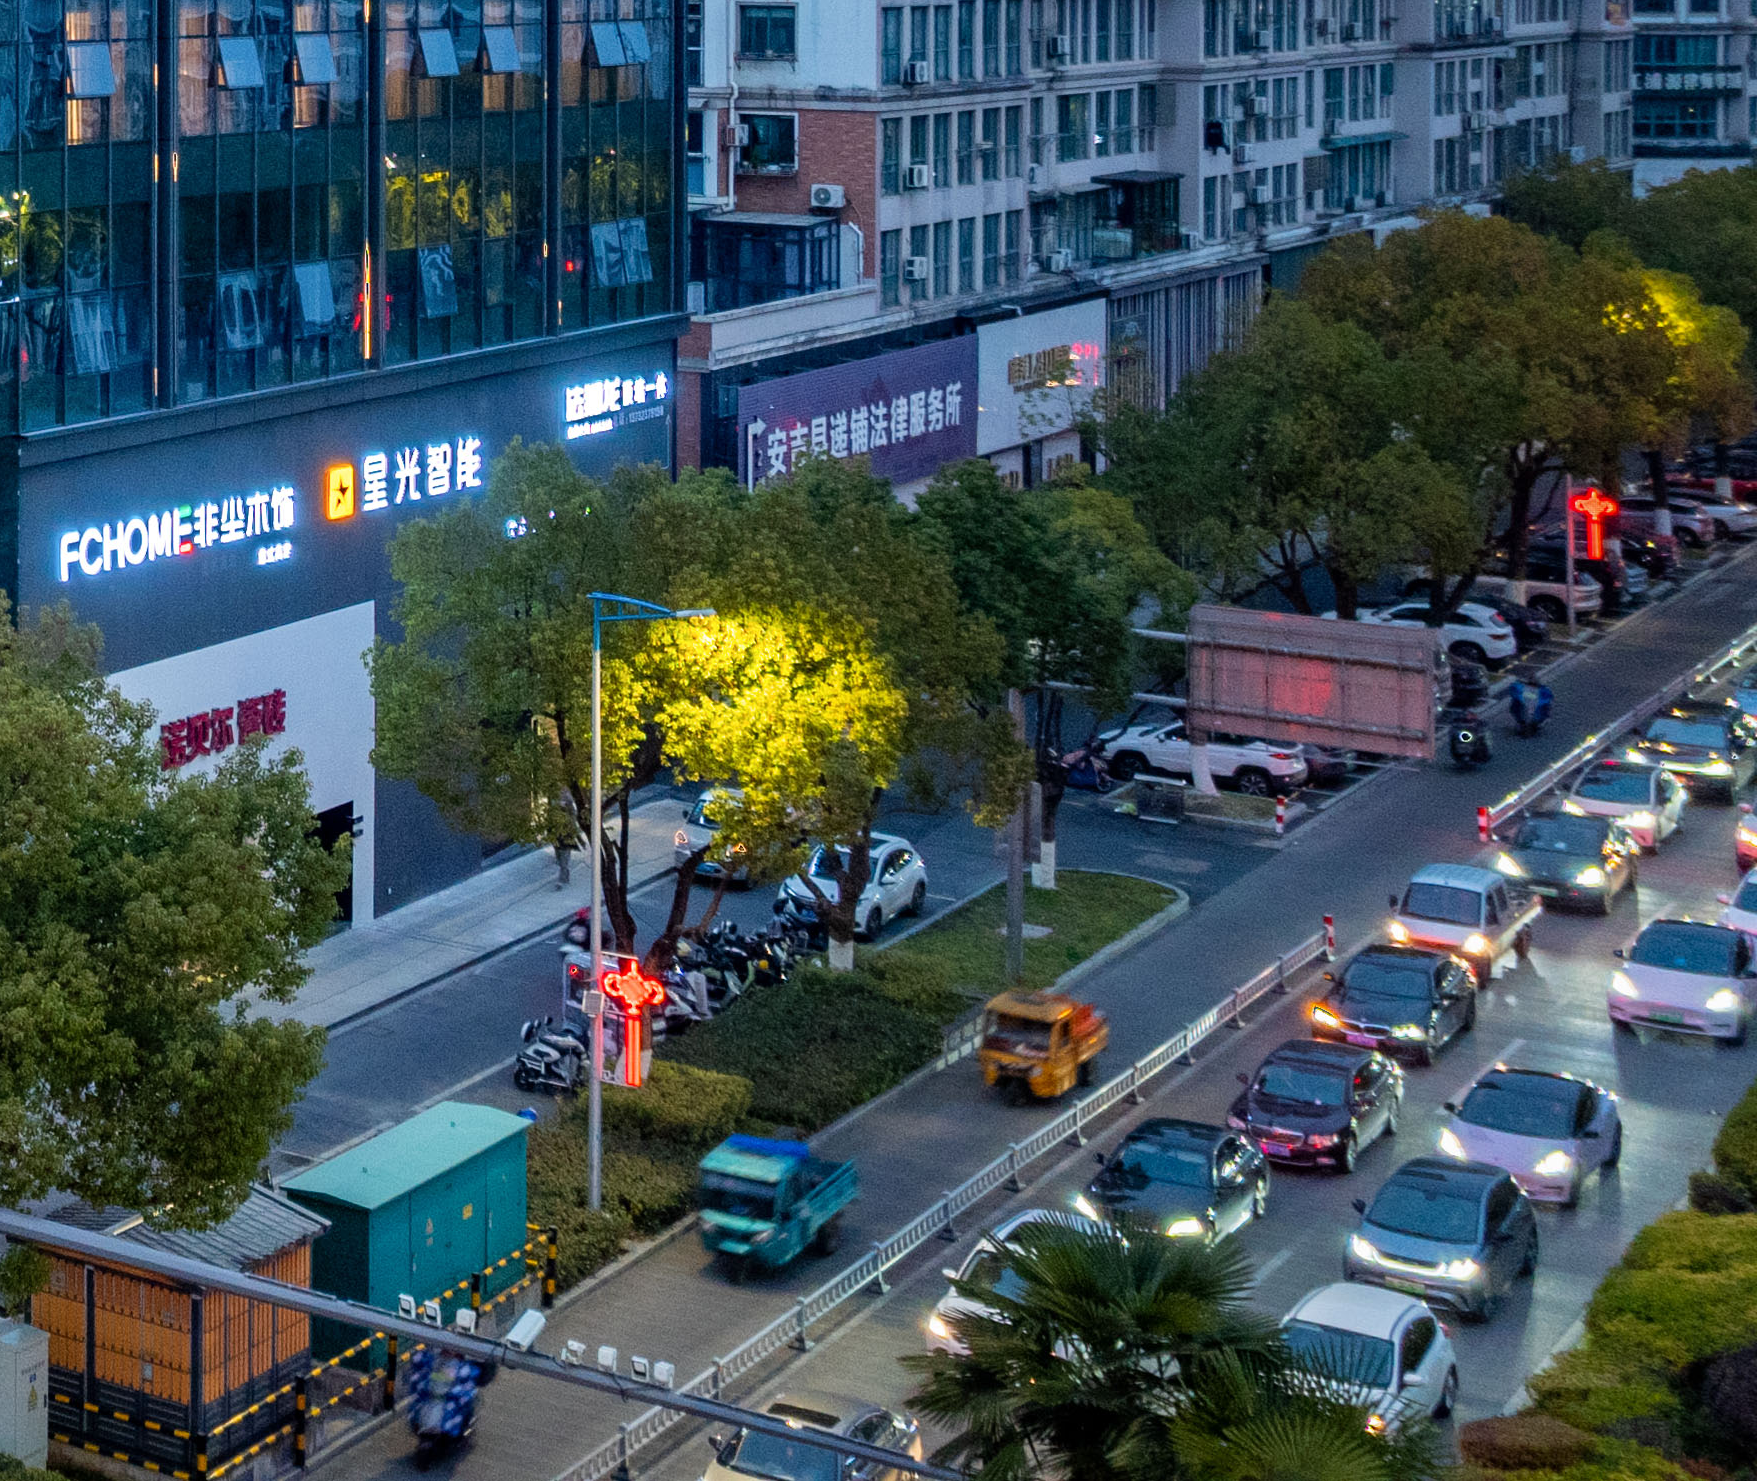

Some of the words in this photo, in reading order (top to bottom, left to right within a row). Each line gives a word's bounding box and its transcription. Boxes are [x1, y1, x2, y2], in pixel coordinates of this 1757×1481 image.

[362, 435, 483, 512] 星光智能
[59, 505, 194, 582] FCHOME
